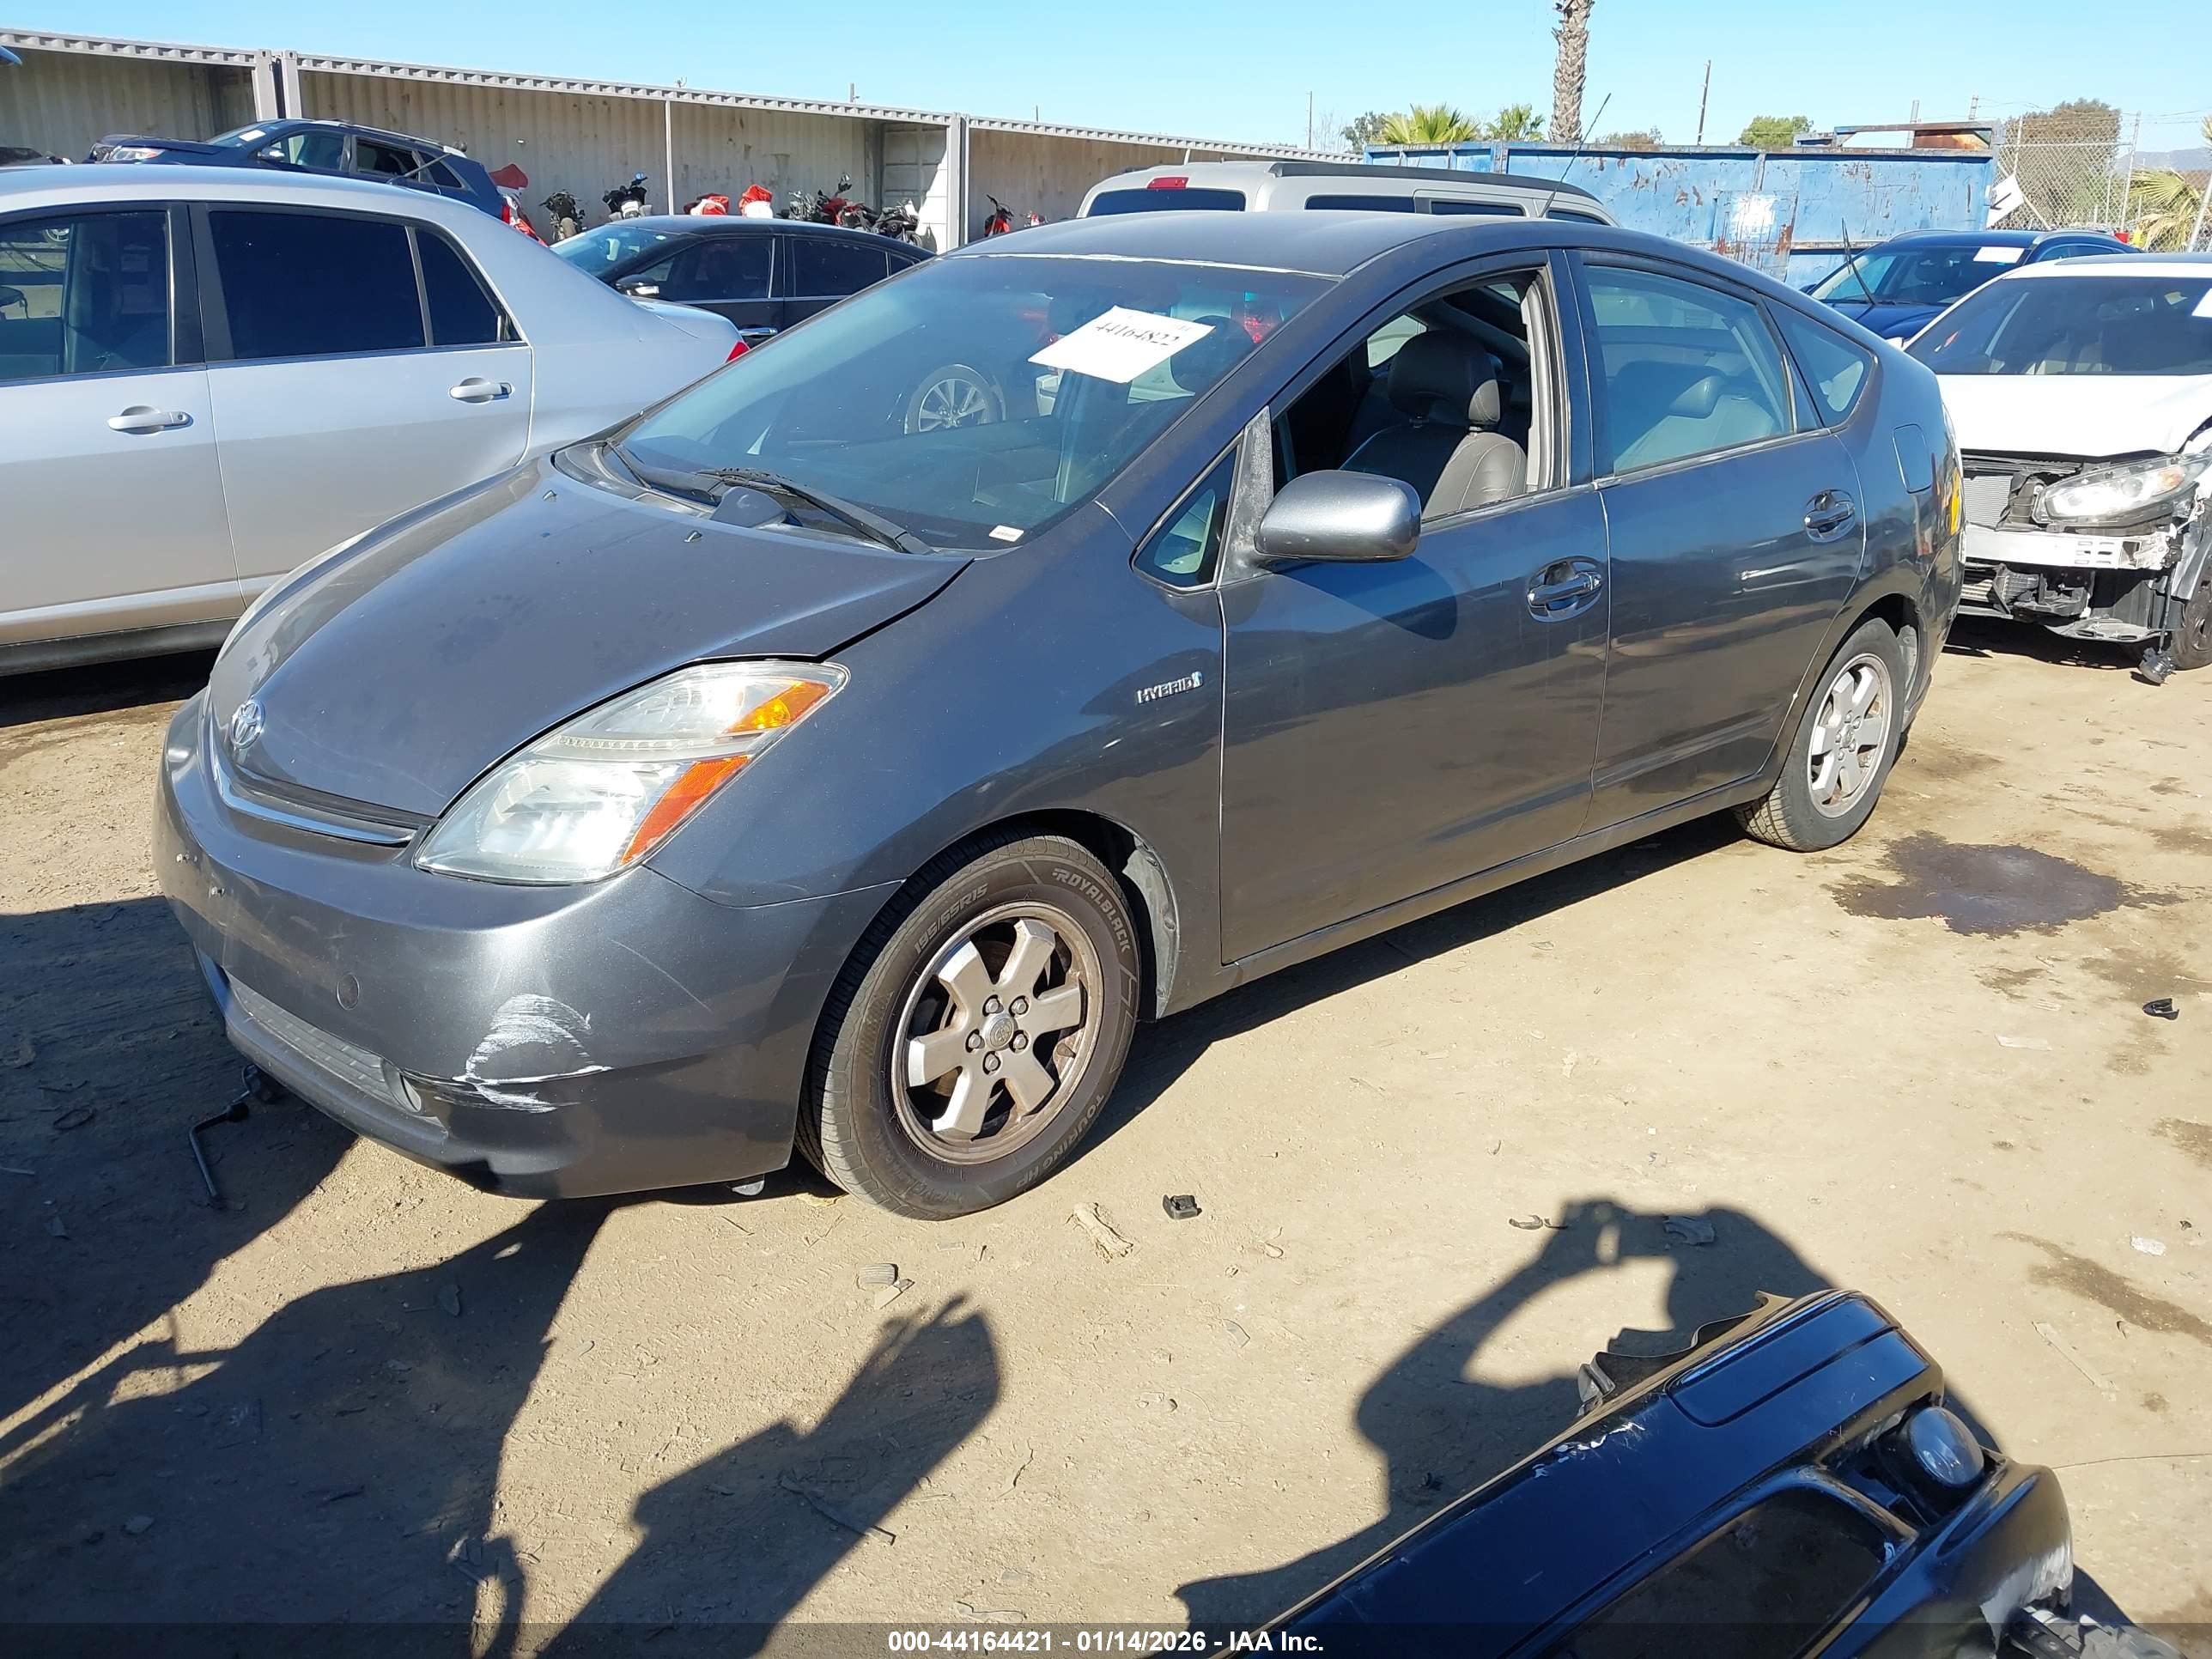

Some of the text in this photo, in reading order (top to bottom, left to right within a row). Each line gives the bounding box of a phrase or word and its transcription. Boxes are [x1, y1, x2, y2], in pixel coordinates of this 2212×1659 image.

[1137, 677, 1194, 704] HYBRID
[914, 883, 988, 955] 195/65R15
[1052, 867, 1132, 953] ROYALBLACK
[1042, 1094, 1105, 1169] TOURING
[1016, 1165, 1040, 1188] HP
